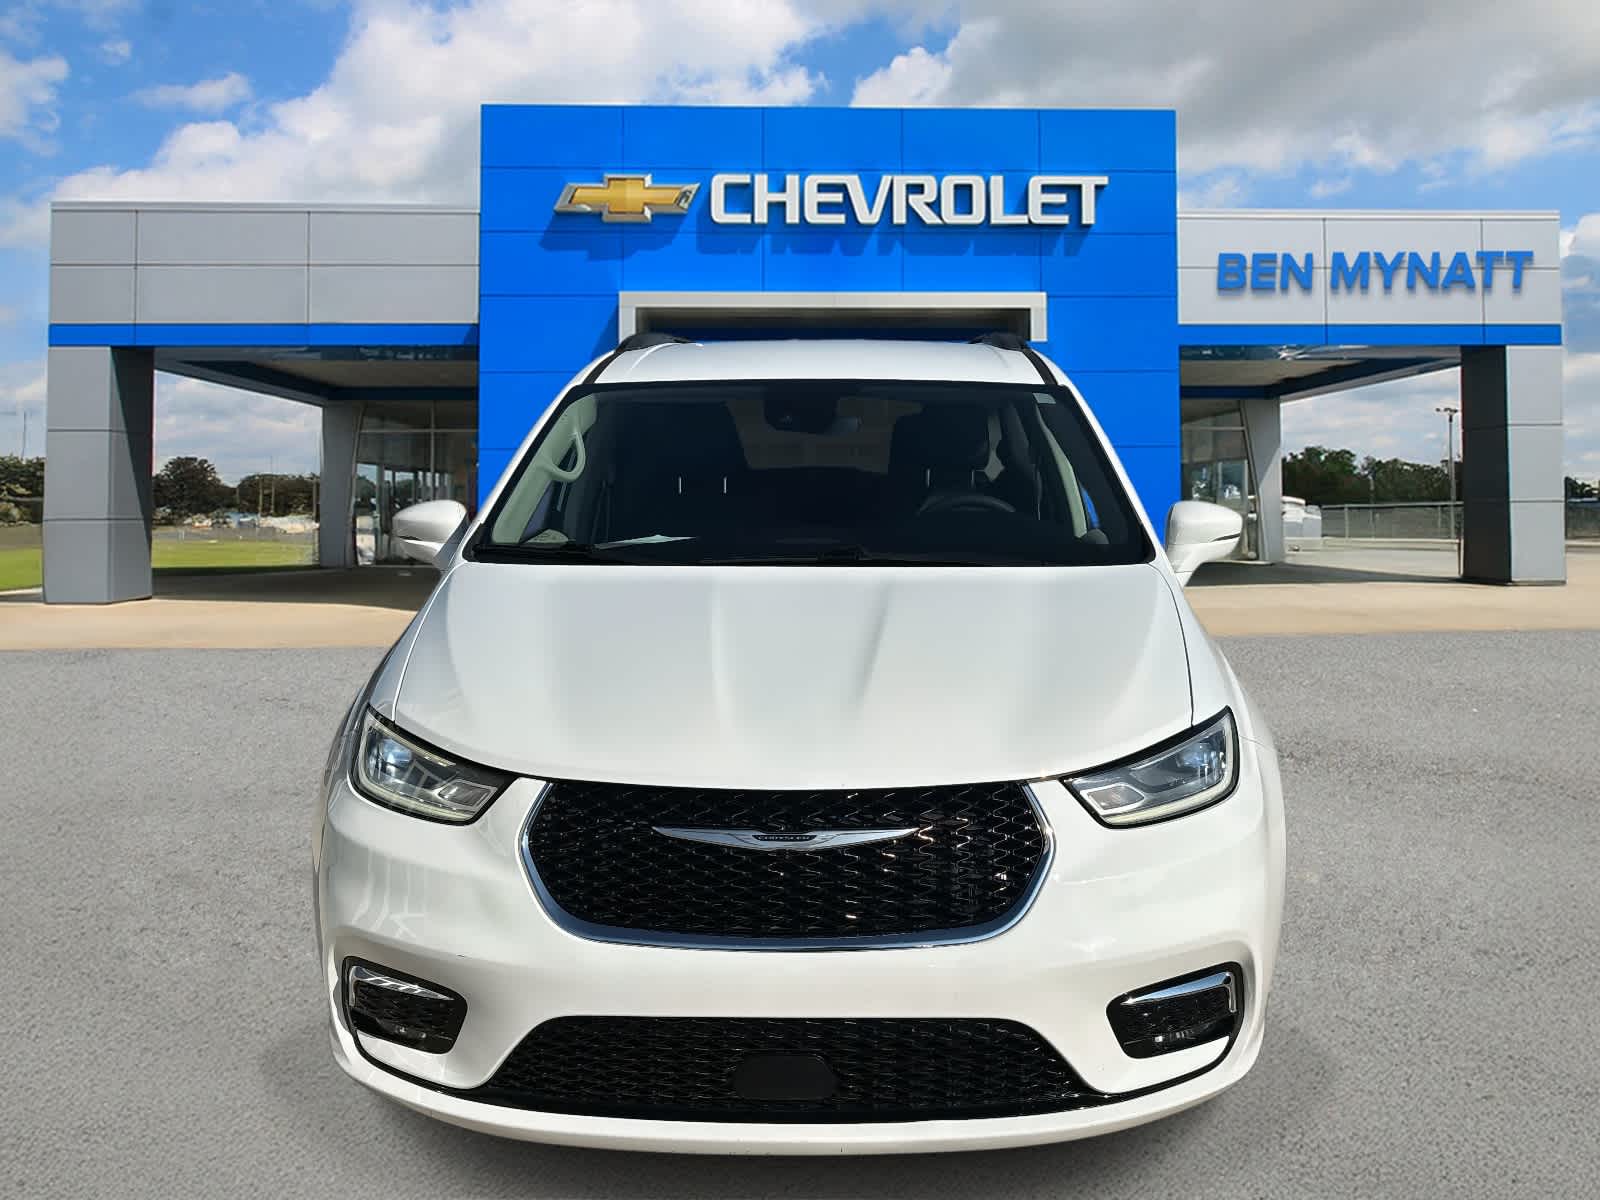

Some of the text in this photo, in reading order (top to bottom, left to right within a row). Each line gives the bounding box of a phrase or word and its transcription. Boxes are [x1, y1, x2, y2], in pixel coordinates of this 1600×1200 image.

[710, 173, 1109, 225] CHEVROLET
[1217, 250, 1534, 290] BEN MYNATT
